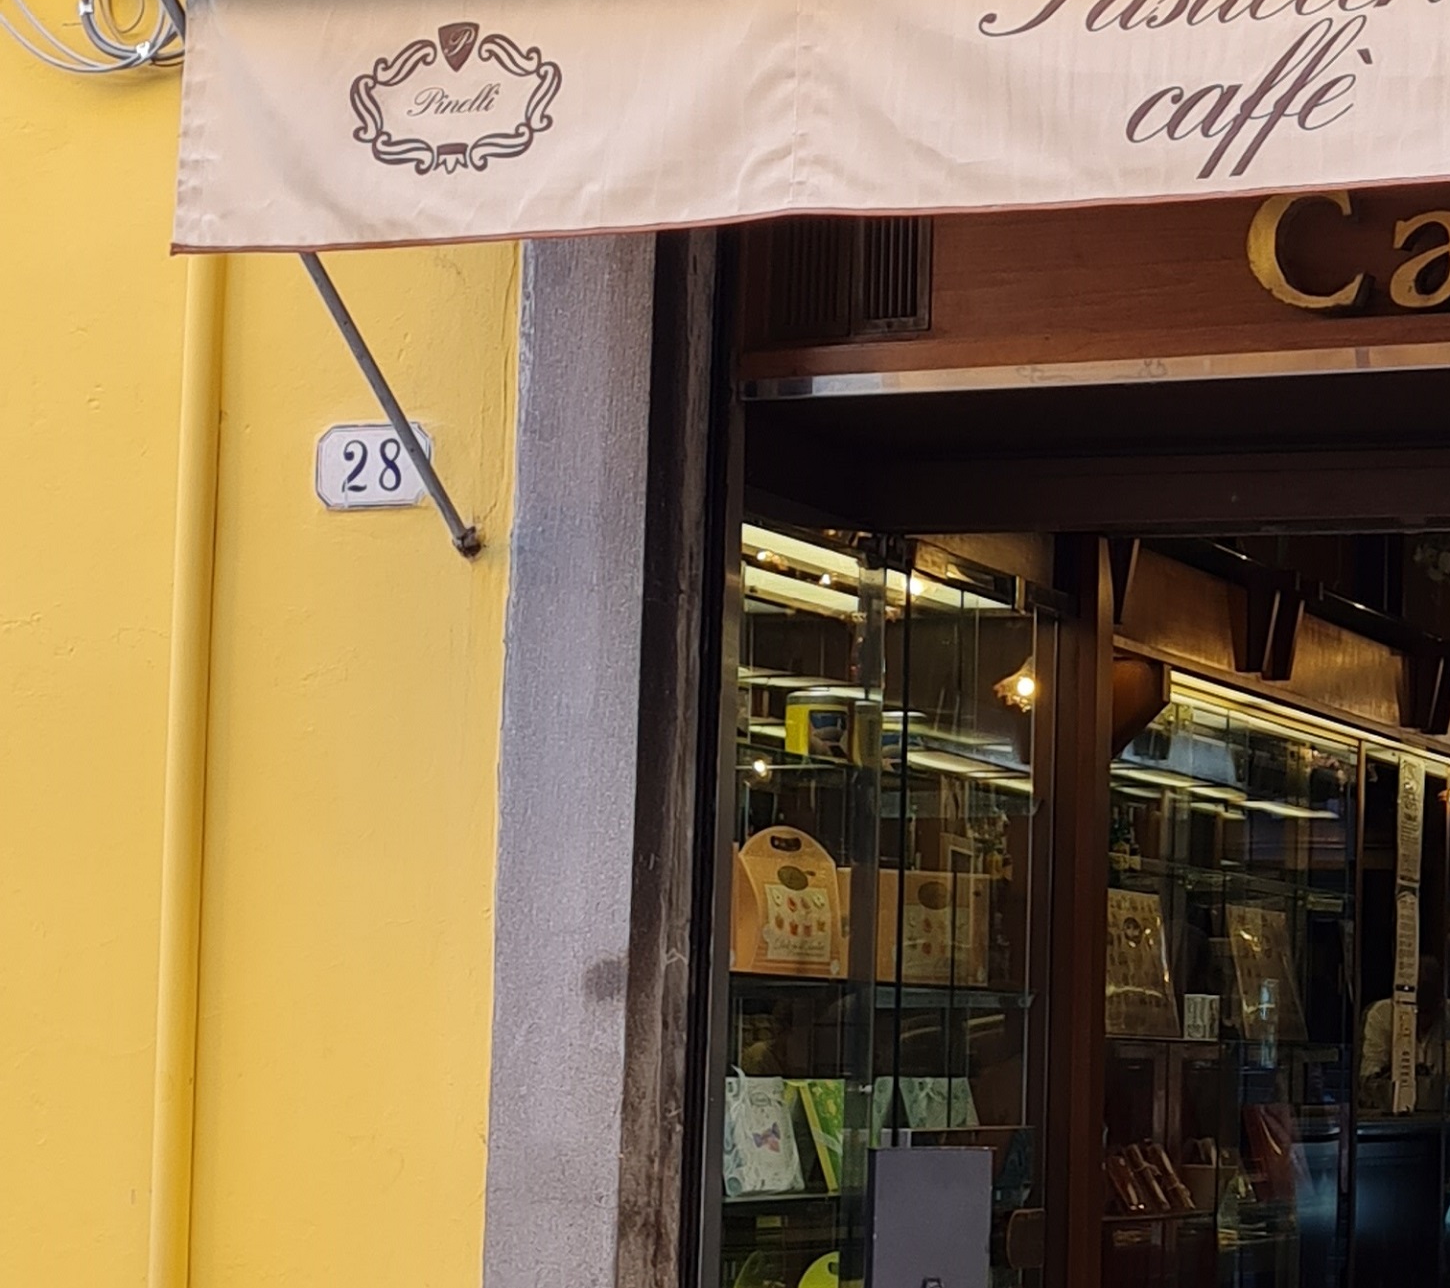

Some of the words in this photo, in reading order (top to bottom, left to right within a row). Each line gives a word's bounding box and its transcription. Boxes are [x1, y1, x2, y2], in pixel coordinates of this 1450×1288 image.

[406, 82, 501, 117] Pinelli
[1126, 14, 1374, 180] caffè
[341, 437, 402, 493] 28
